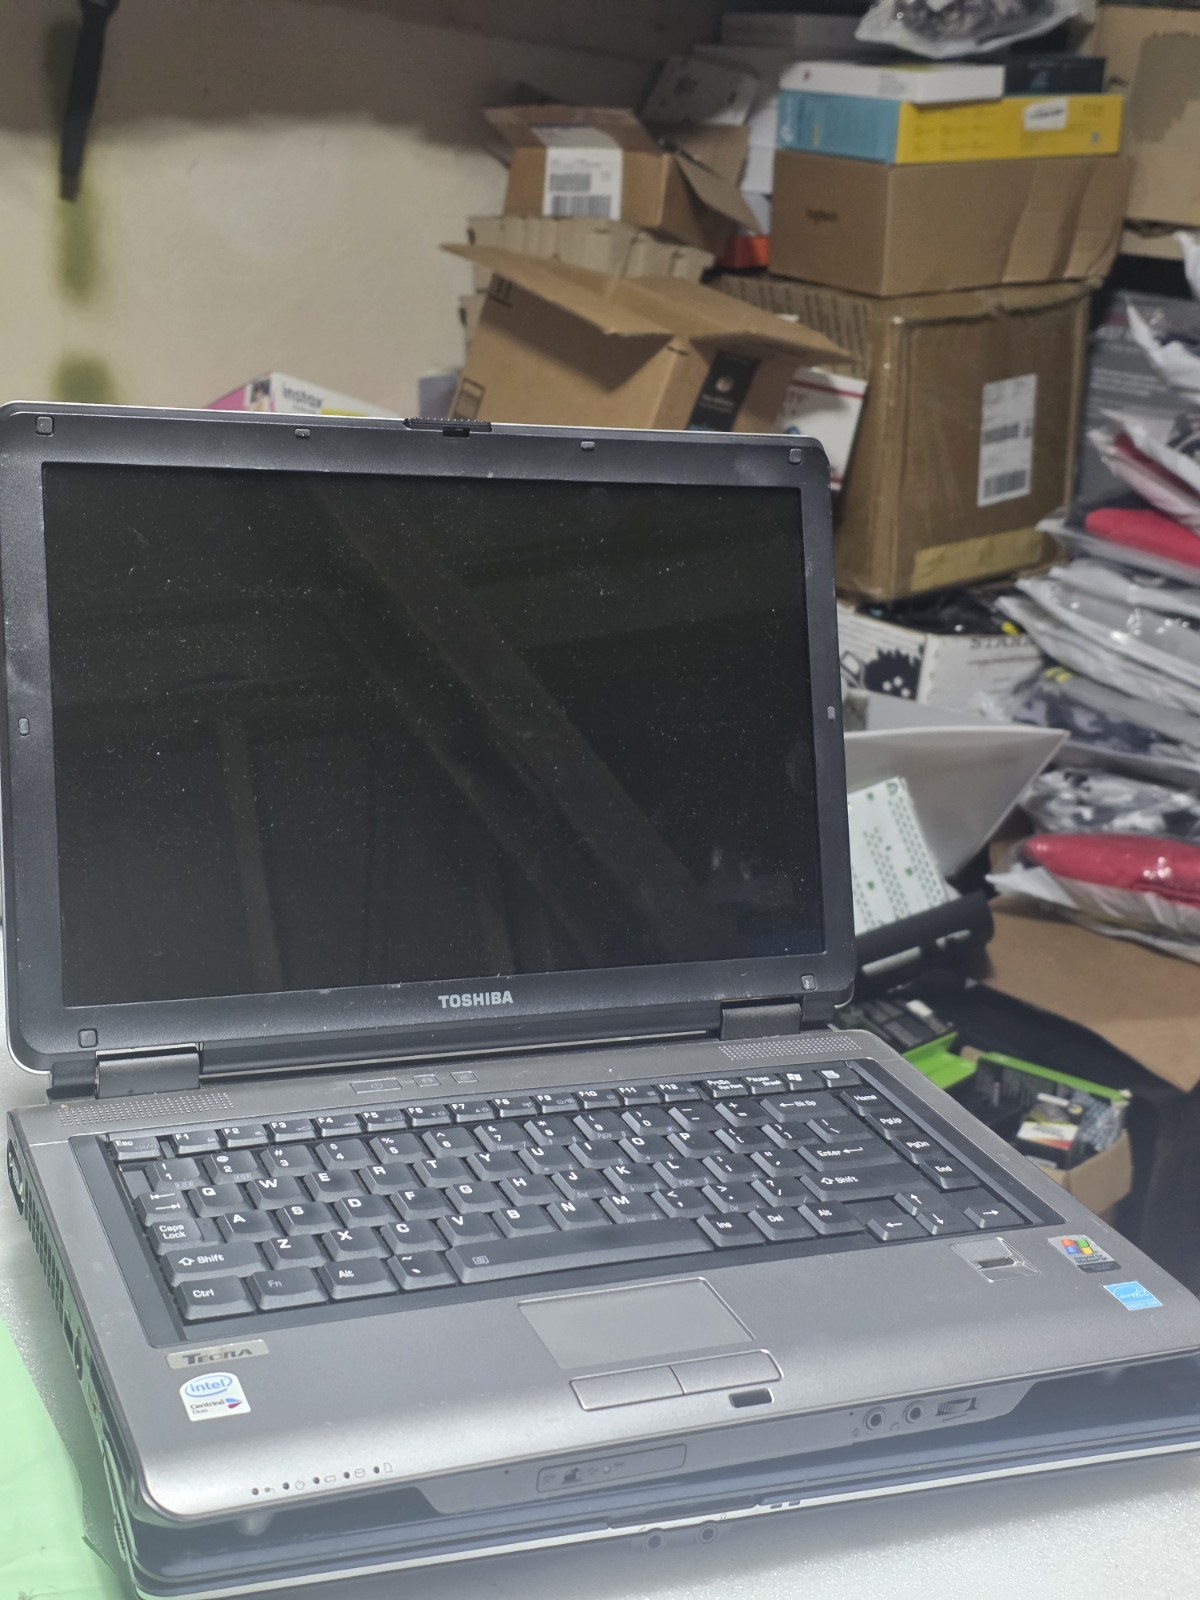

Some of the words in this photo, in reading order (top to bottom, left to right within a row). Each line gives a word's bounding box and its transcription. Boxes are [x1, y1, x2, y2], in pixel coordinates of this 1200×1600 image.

[438, 990, 514, 1009] TOSHIBA
[619, 1086, 637, 1094] F11
[658, 1083, 679, 1091] F12
[879, 1117, 902, 1125] PgUp
[679, 1132, 691, 1141] P
[442, 1140, 452, 1148] 6
[631, 1137, 645, 1146] O
[906, 1140, 930, 1149] PgDn
[388, 1146, 399, 1154] 5
[530, 1147, 545, 1156] U
[335, 1152, 345, 1160] 4
[479, 1153, 491, 1162] Y
[279, 1159, 290, 1167] 3
[426, 1160, 438, 1169] T
[666, 1161, 680, 1169] L
[223, 1165, 233, 1173] 2
[372, 1166, 387, 1175] R
[616, 1166, 631, 1175] K
[935, 1165, 953, 1173] End
[317, 1172, 331, 1182] E
[568, 1172, 578, 1180] J
[834, 1175, 859, 1185] Shift
[258, 1178, 278, 1189] W
[512, 1178, 527, 1187] H
[202, 1187, 217, 1196] Q
[459, 1185, 473, 1194] G
[404, 1191, 416, 1200] F
[612, 1195, 630, 1205] M
[348, 1198, 362, 1208] D
[560, 1202, 576, 1212] N
[291, 1206, 304, 1215] S
[506, 1209, 521, 1219] B
[817, 1209, 833, 1217] Alt
[233, 1214, 246, 1224] A
[452, 1216, 464, 1226] V
[767, 1214, 785, 1223] Del
[158, 1224, 185, 1233] Caps
[396, 1223, 410, 1233] C
[716, 1220, 733, 1229] Ins
[162, 1231, 187, 1240] Lock
[337, 1230, 353, 1241] X
[277, 1239, 291, 1249] Z
[196, 1253, 225, 1265] Shift
[338, 1269, 355, 1279] Alt
[267, 1280, 282, 1288] Fn
[192, 1288, 215, 1298] Ctrl
[189, 1378, 227, 1393] intel
